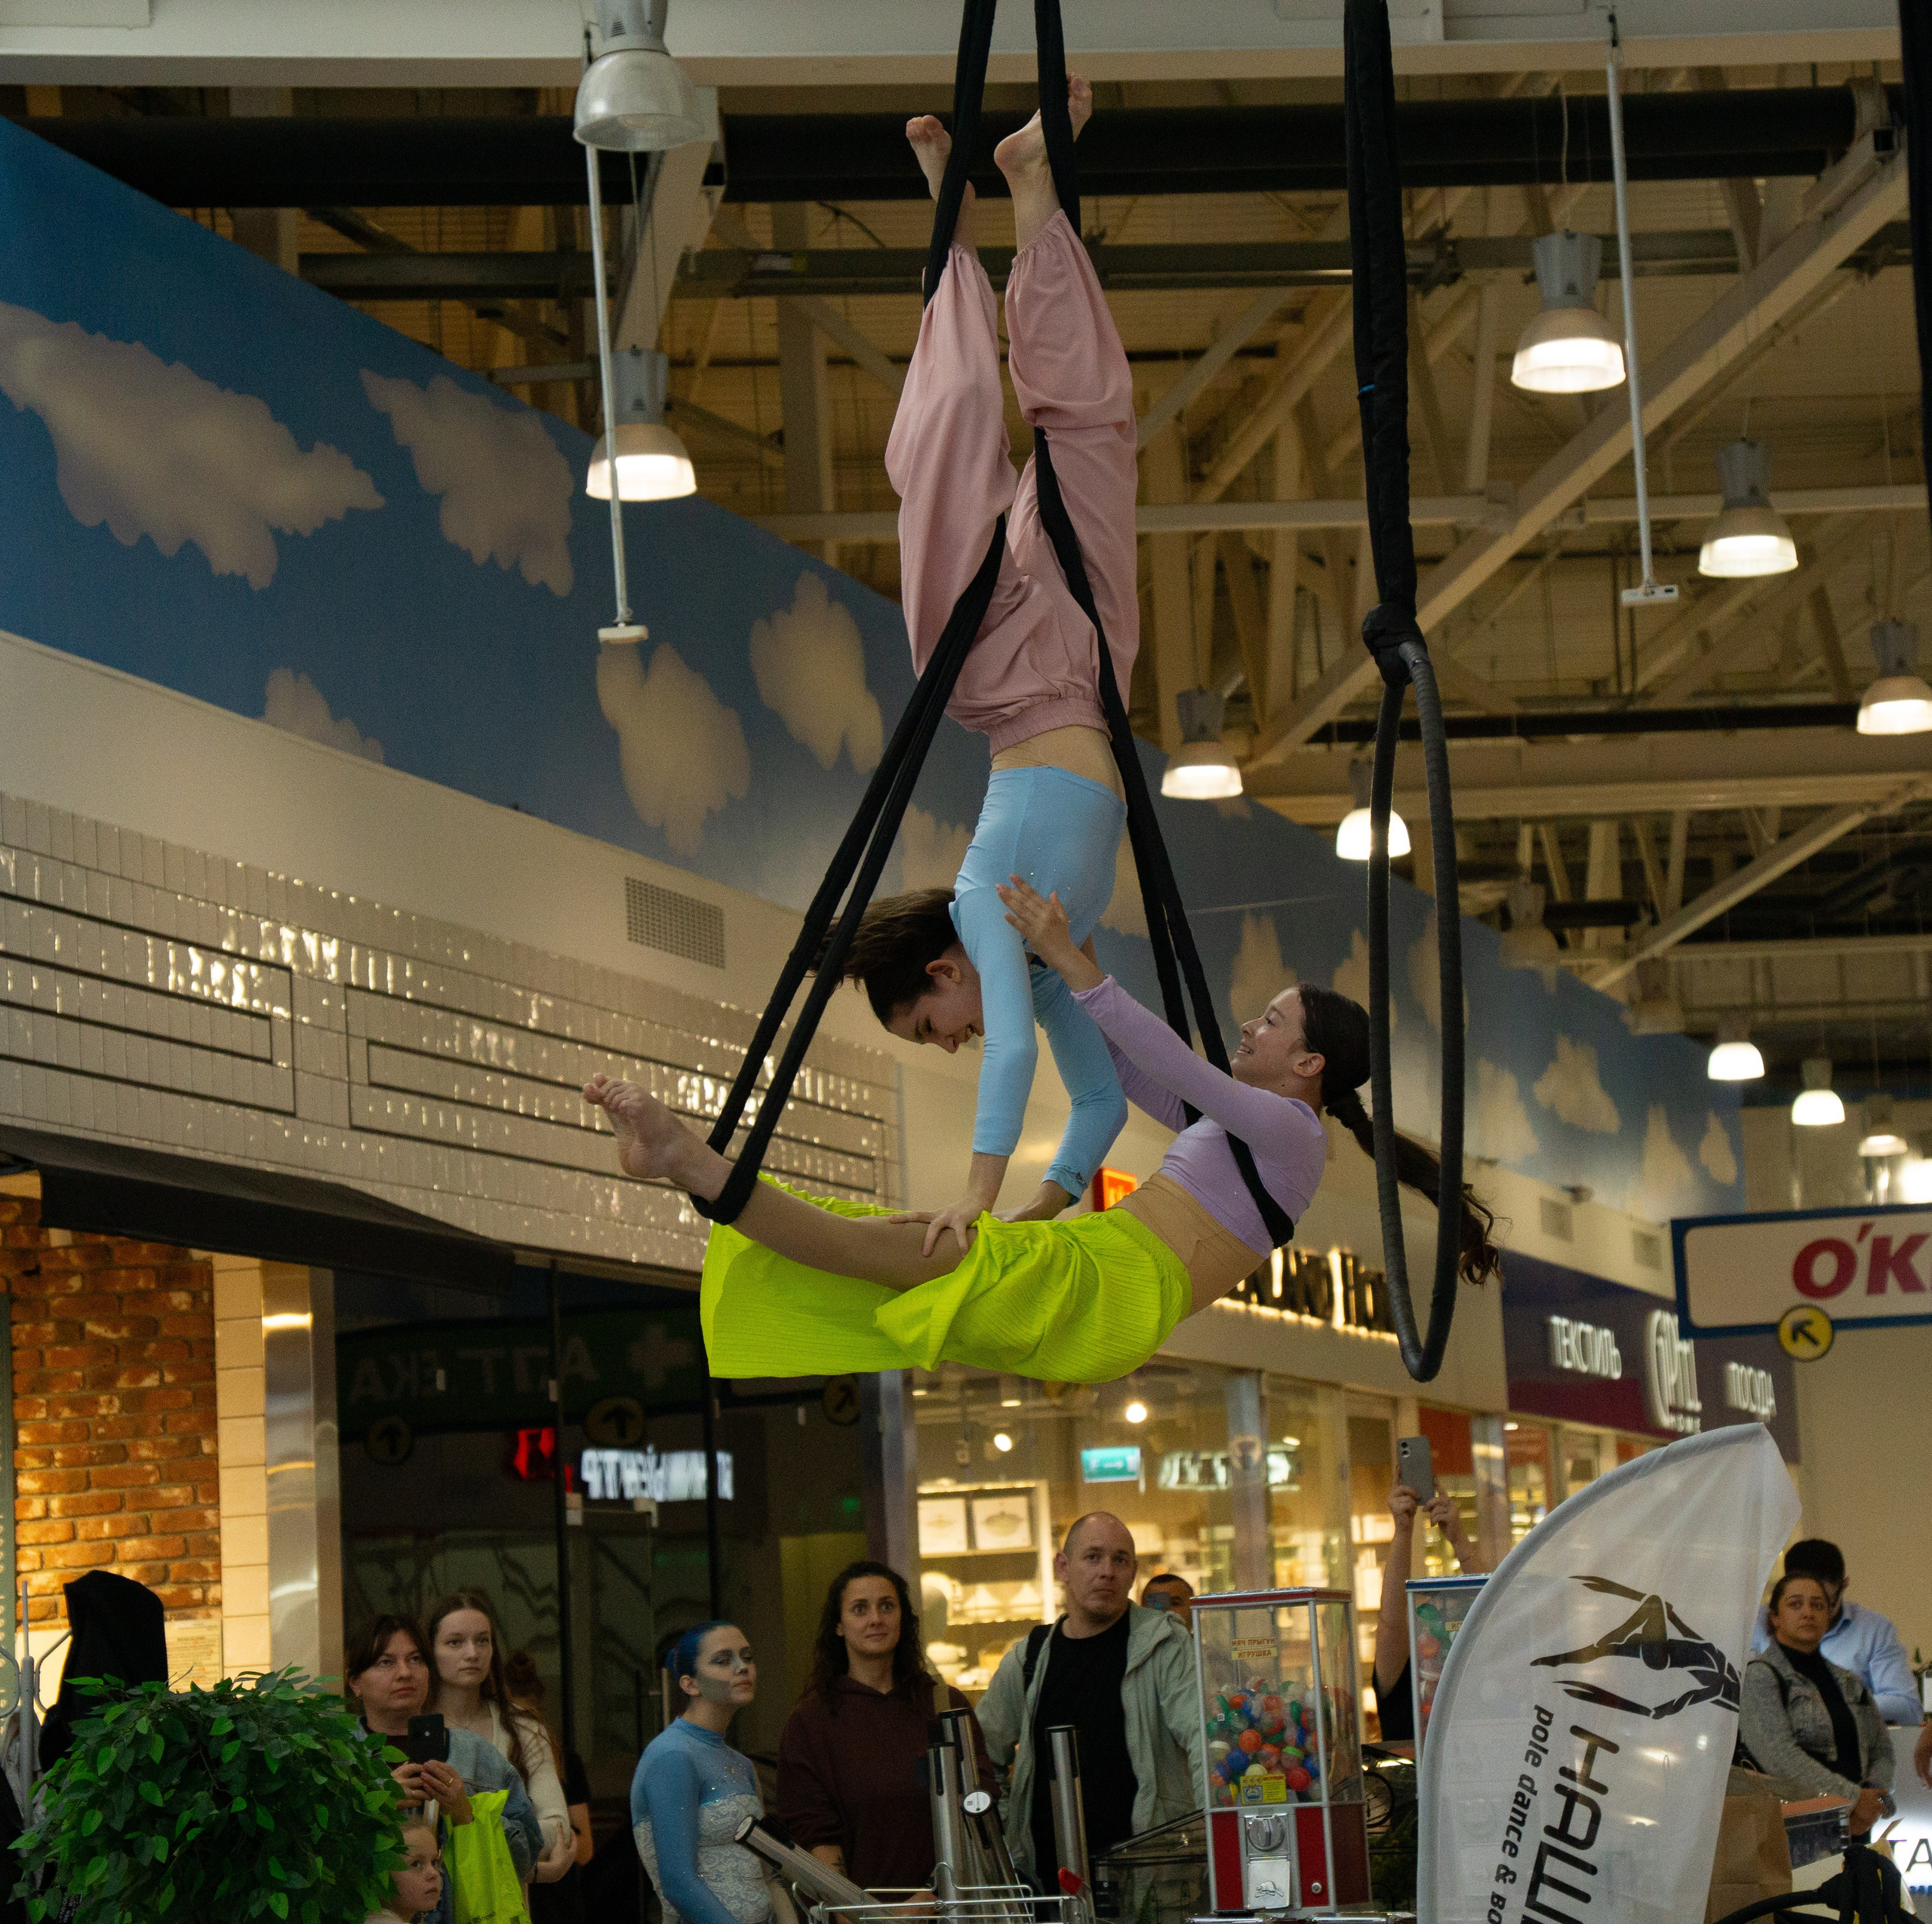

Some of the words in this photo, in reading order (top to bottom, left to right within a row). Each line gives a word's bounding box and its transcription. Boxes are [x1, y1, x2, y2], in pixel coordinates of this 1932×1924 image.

[1792, 1221, 1932, 1300] O'K
[1524, 1704, 1555, 1769] pole
[1502, 1773, 1538, 1859] dance
[1521, 1724, 1620, 1924] НАШ
[1494, 1863, 1518, 1885] &
